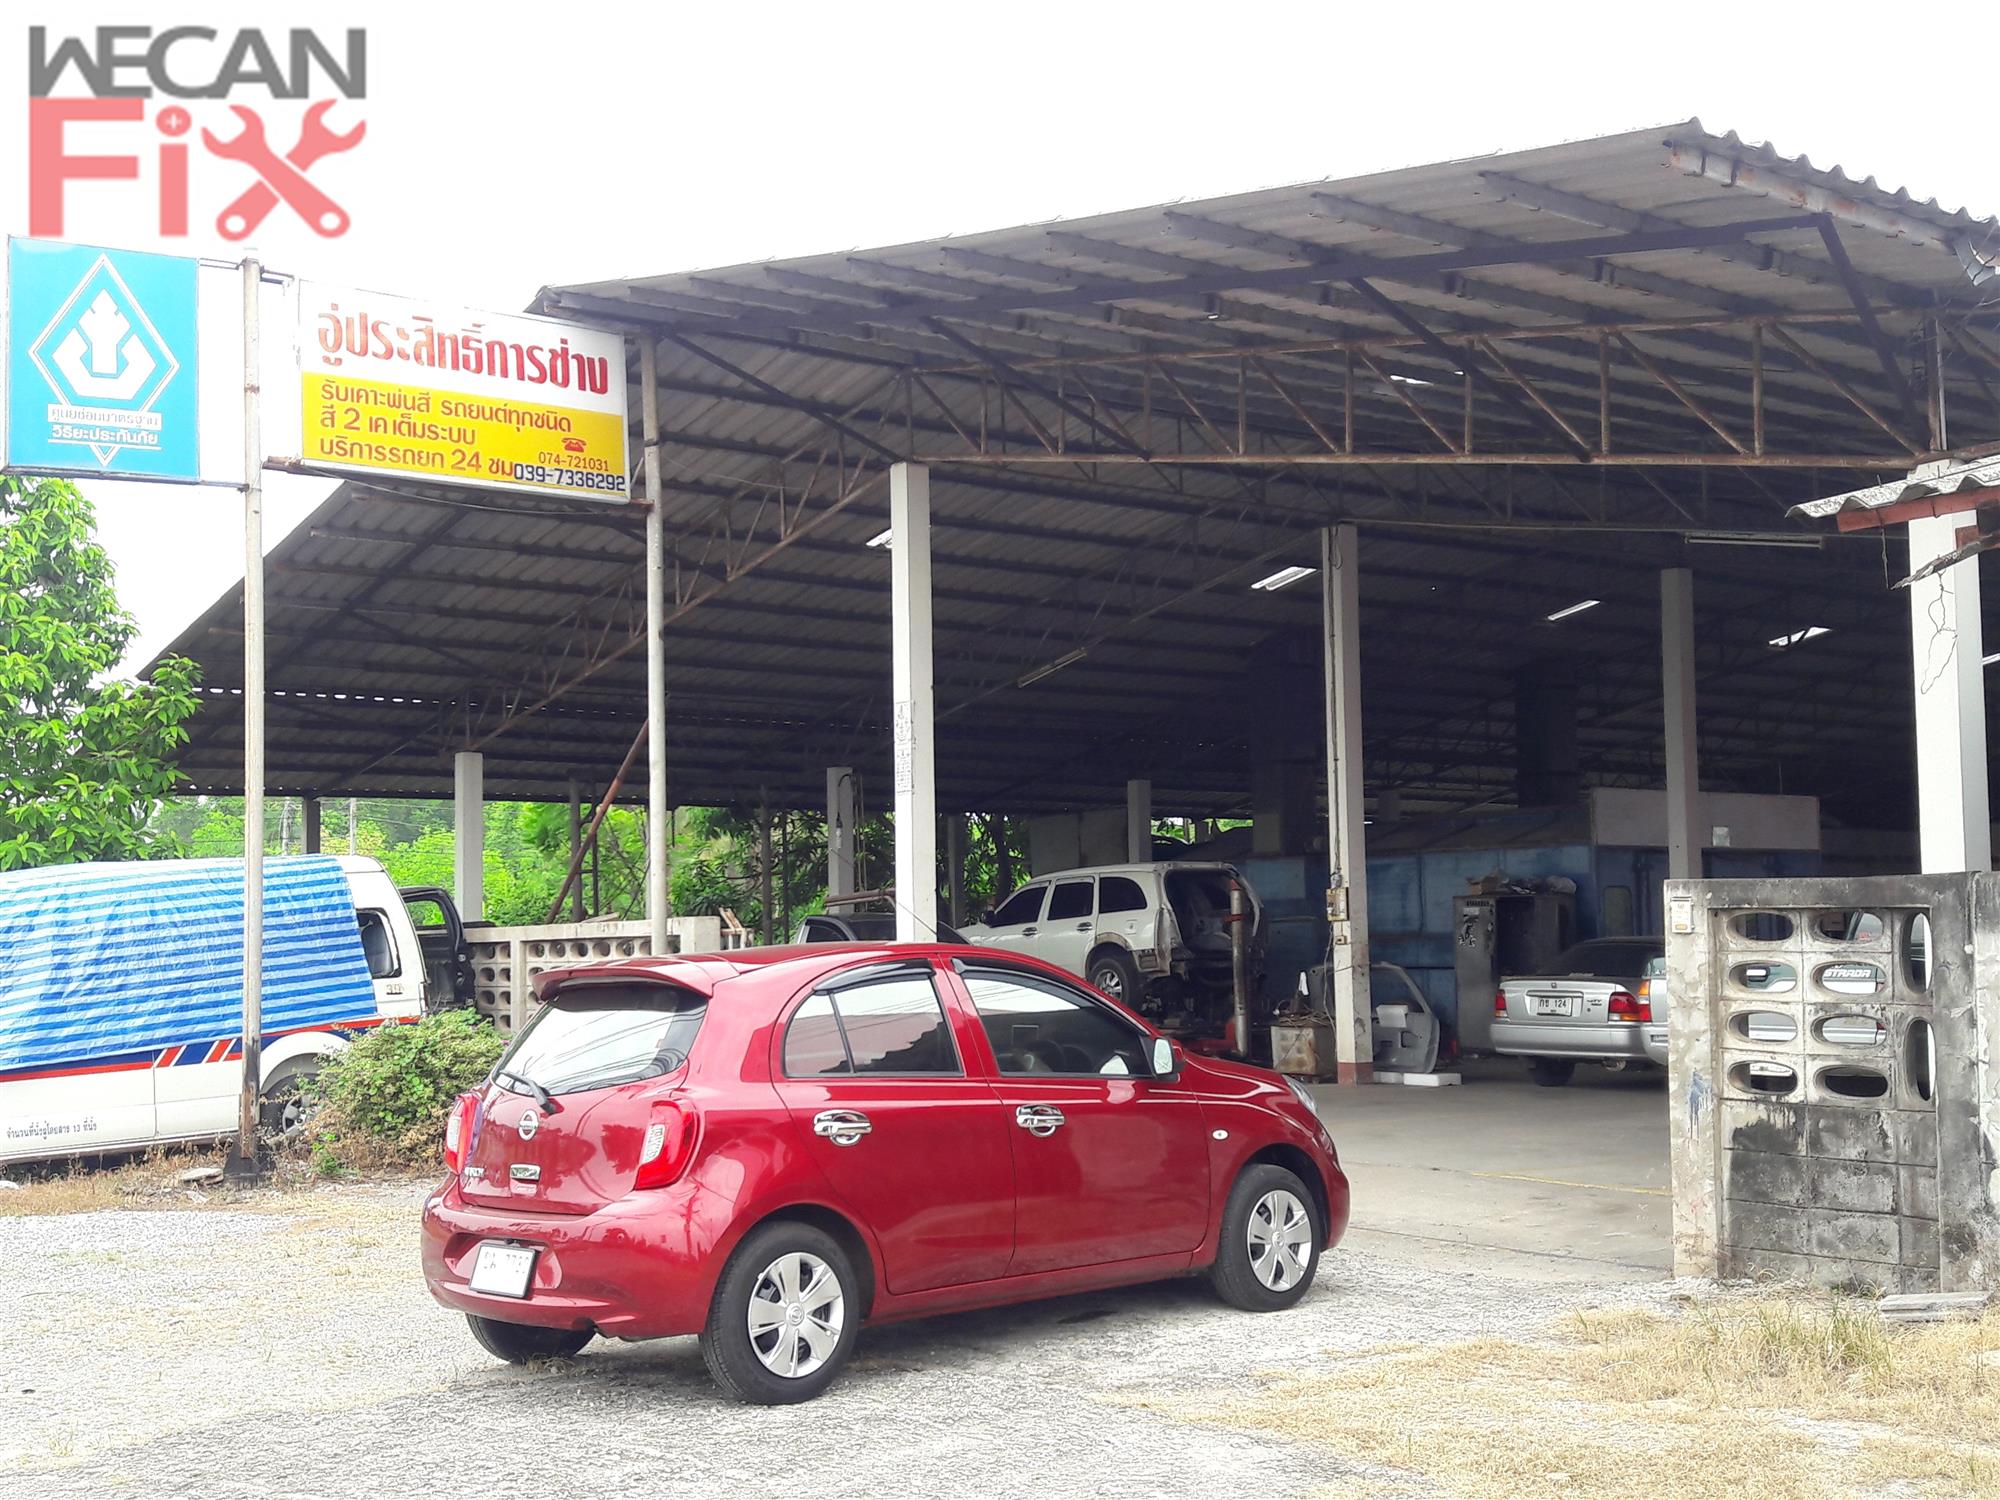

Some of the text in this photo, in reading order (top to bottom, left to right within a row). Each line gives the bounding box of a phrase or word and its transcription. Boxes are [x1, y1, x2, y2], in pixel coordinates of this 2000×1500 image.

[318, 303, 608, 395] อู่ประสิทธิ์การช่าง
[320, 404, 336, 428] สี
[343, 407, 361, 431] 2
[321, 379, 572, 432] รับเคาะพ่นสี รถยนต์ทุกชนิด
[52, 423, 158, 445] วิริยะประกันภัย
[320, 434, 445, 468] บริการรถยก
[450, 448, 482, 473] 24
[538, 451, 610, 472] 074-721031
[514, 463, 627, 492] 039-7336292
[1554, 999, 1567, 1009] 124
